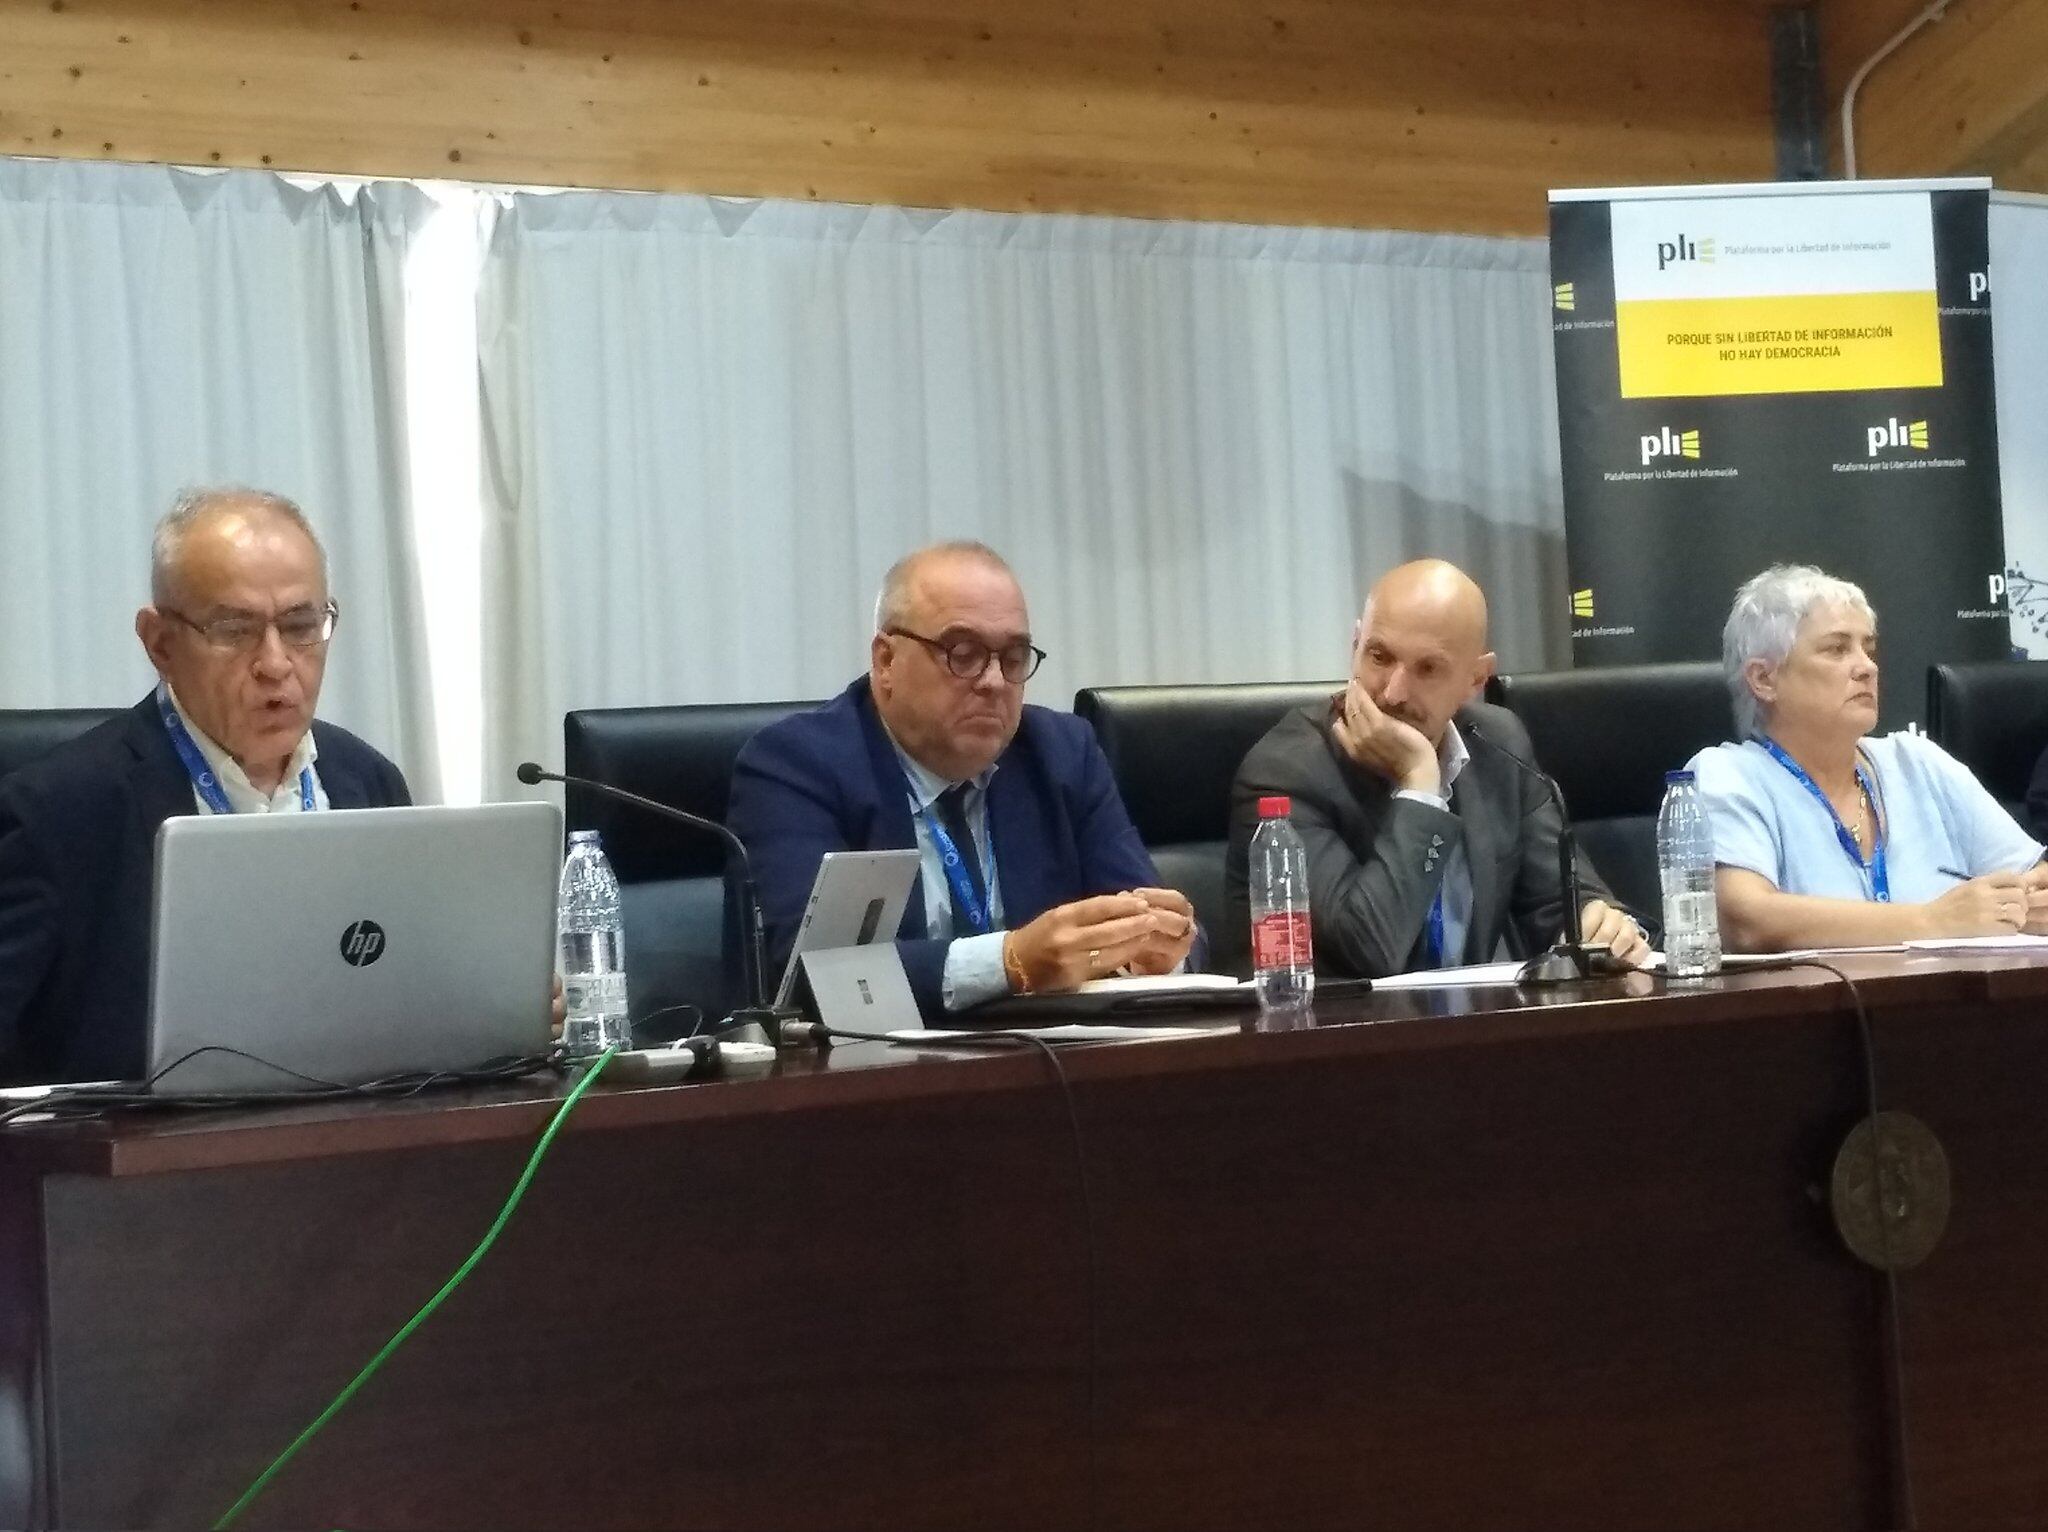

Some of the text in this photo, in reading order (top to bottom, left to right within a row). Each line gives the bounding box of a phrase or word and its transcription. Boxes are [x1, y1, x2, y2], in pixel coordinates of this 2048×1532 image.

[1724, 245, 1769, 255] Plataforma
[1667, 325, 1893, 345] PORQUE SIN LIBERTAD DE INFORMACIÓN
[1719, 346, 1841, 361] NO HAY DEMOCRACIA
[1832, 462, 1869, 472] Plataforma
[1889, 459, 1918, 470] Libertad
[1604, 471, 1641, 481] Plataforma
[1641, 472, 1654, 481] por
[1662, 468, 1690, 479] Libertad
[344, 920, 383, 967] hp
